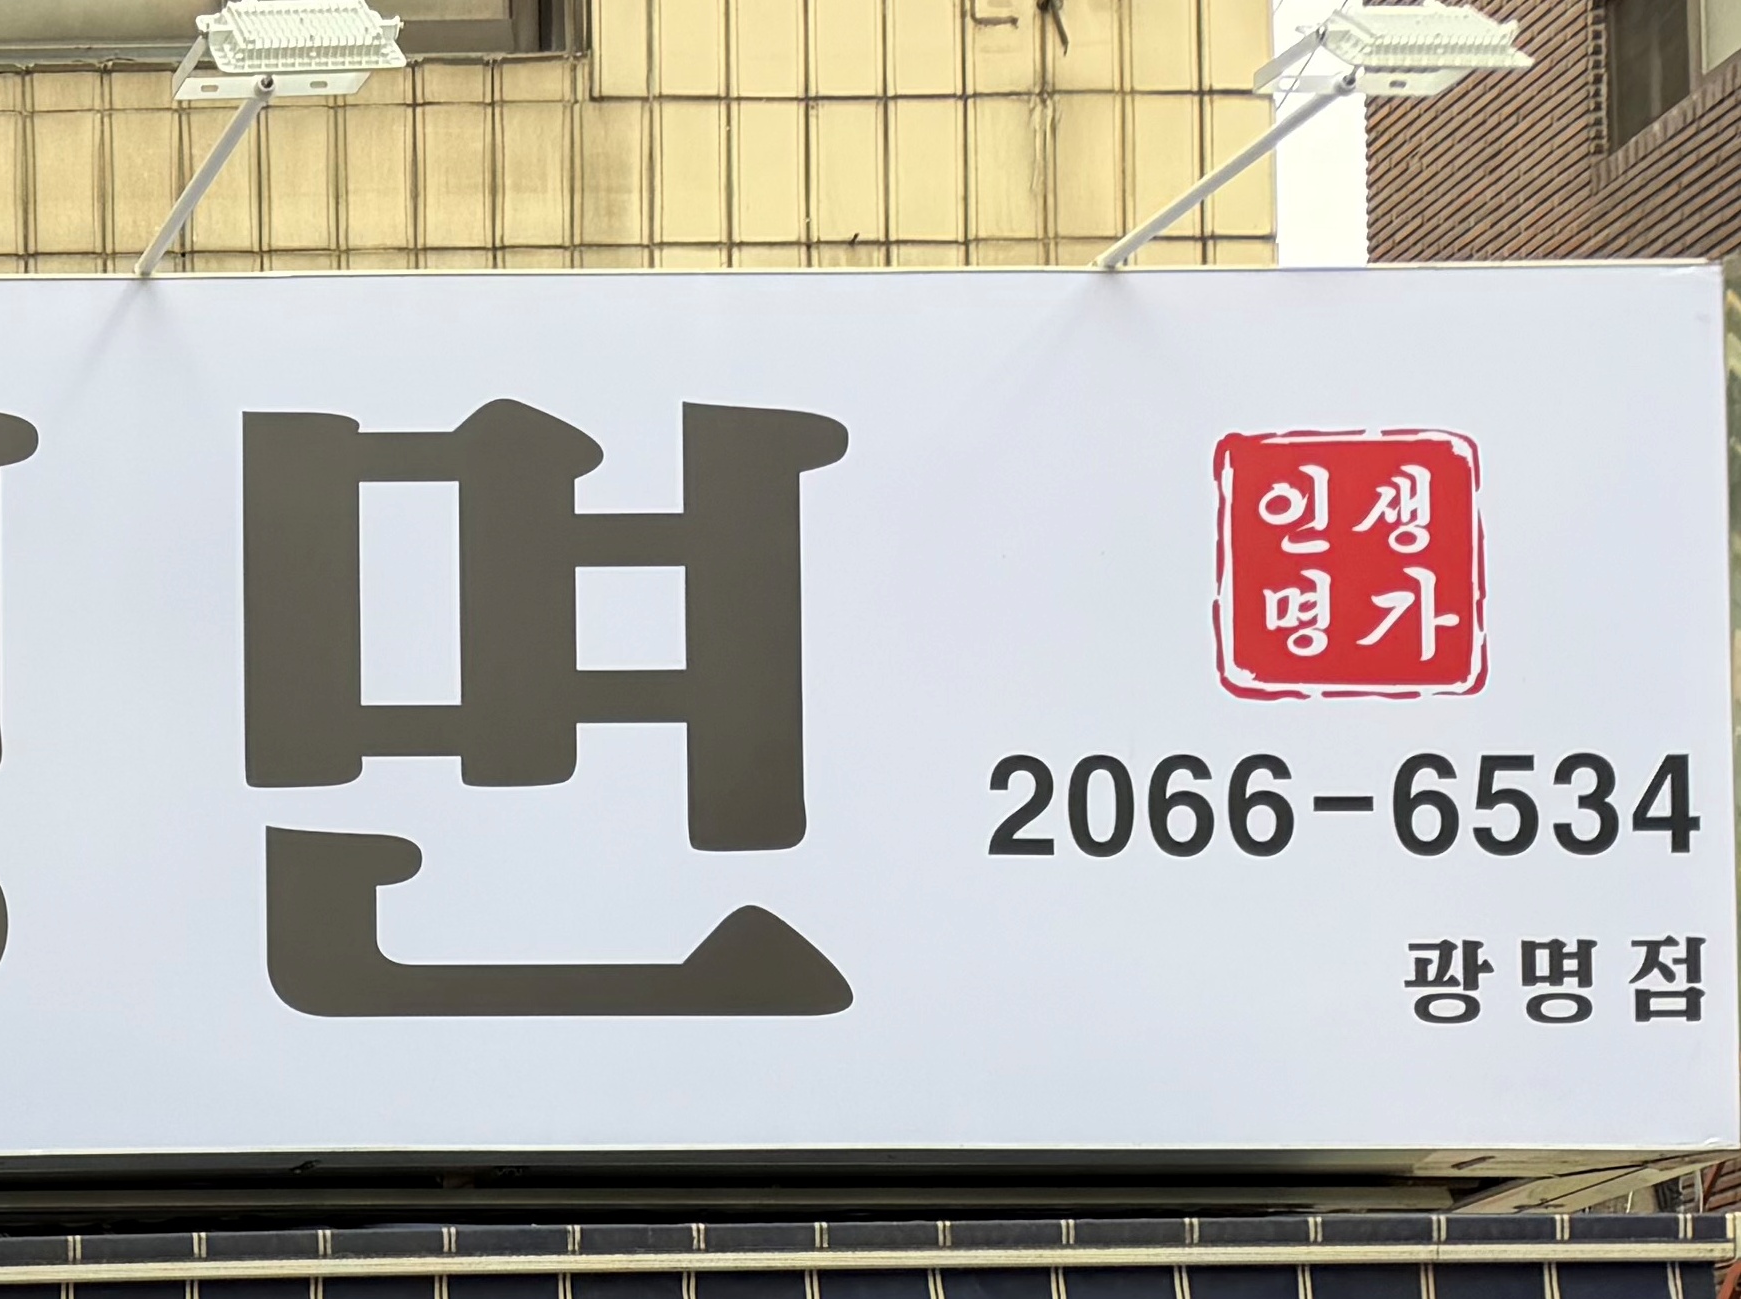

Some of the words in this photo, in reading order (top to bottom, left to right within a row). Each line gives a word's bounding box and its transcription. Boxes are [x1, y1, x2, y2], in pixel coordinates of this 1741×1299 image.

[1258, 464, 1432, 553] 인생
[1263, 567, 1460, 661] 명가
[988, 753, 1702, 858] 2066-6534
[1403, 935, 1706, 1025] 광명점
